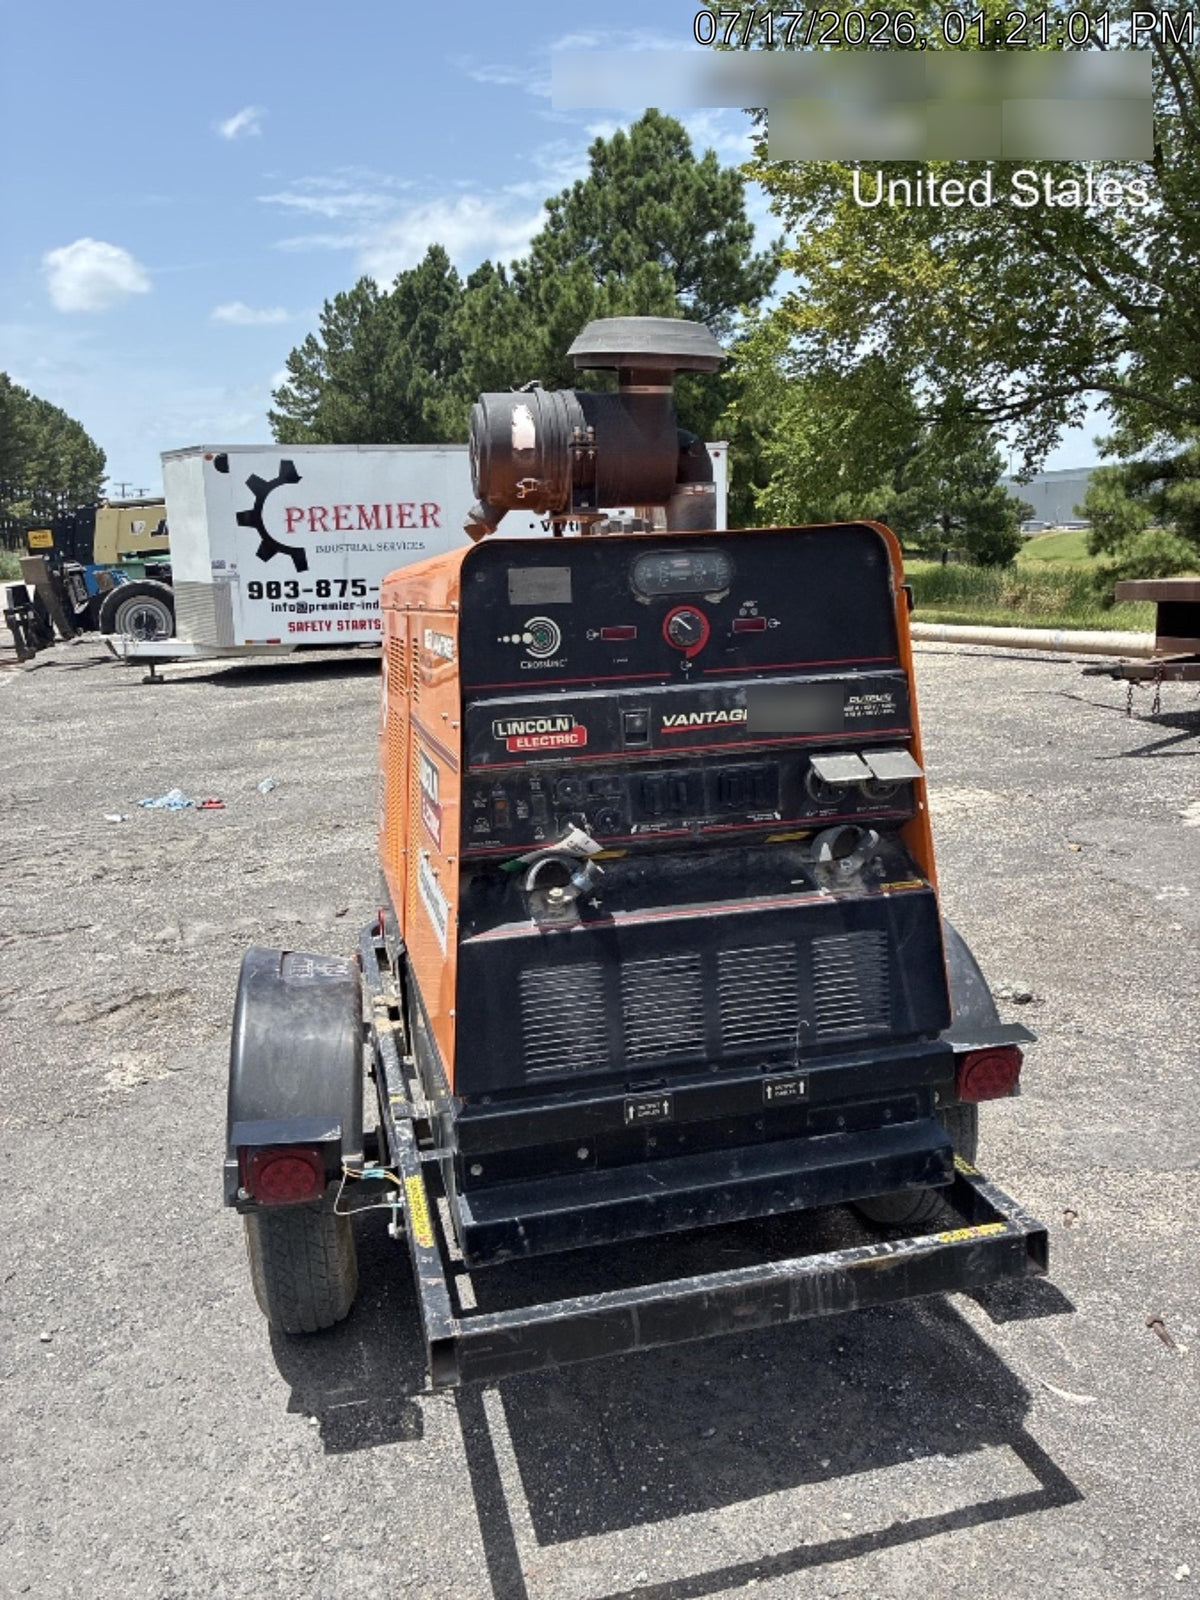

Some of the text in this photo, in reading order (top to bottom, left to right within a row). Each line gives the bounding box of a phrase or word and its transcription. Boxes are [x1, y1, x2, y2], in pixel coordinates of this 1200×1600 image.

[284, 502, 442, 534] PREMIER
[315, 541, 426, 554] INDUSTRIAL SERVICES
[288, 618, 381, 633] SAFETY STARTS
[662, 708, 748, 727] VANTAG
[496, 717, 570, 737] LINCOLN
[516, 733, 579, 748] ELECTRIC
